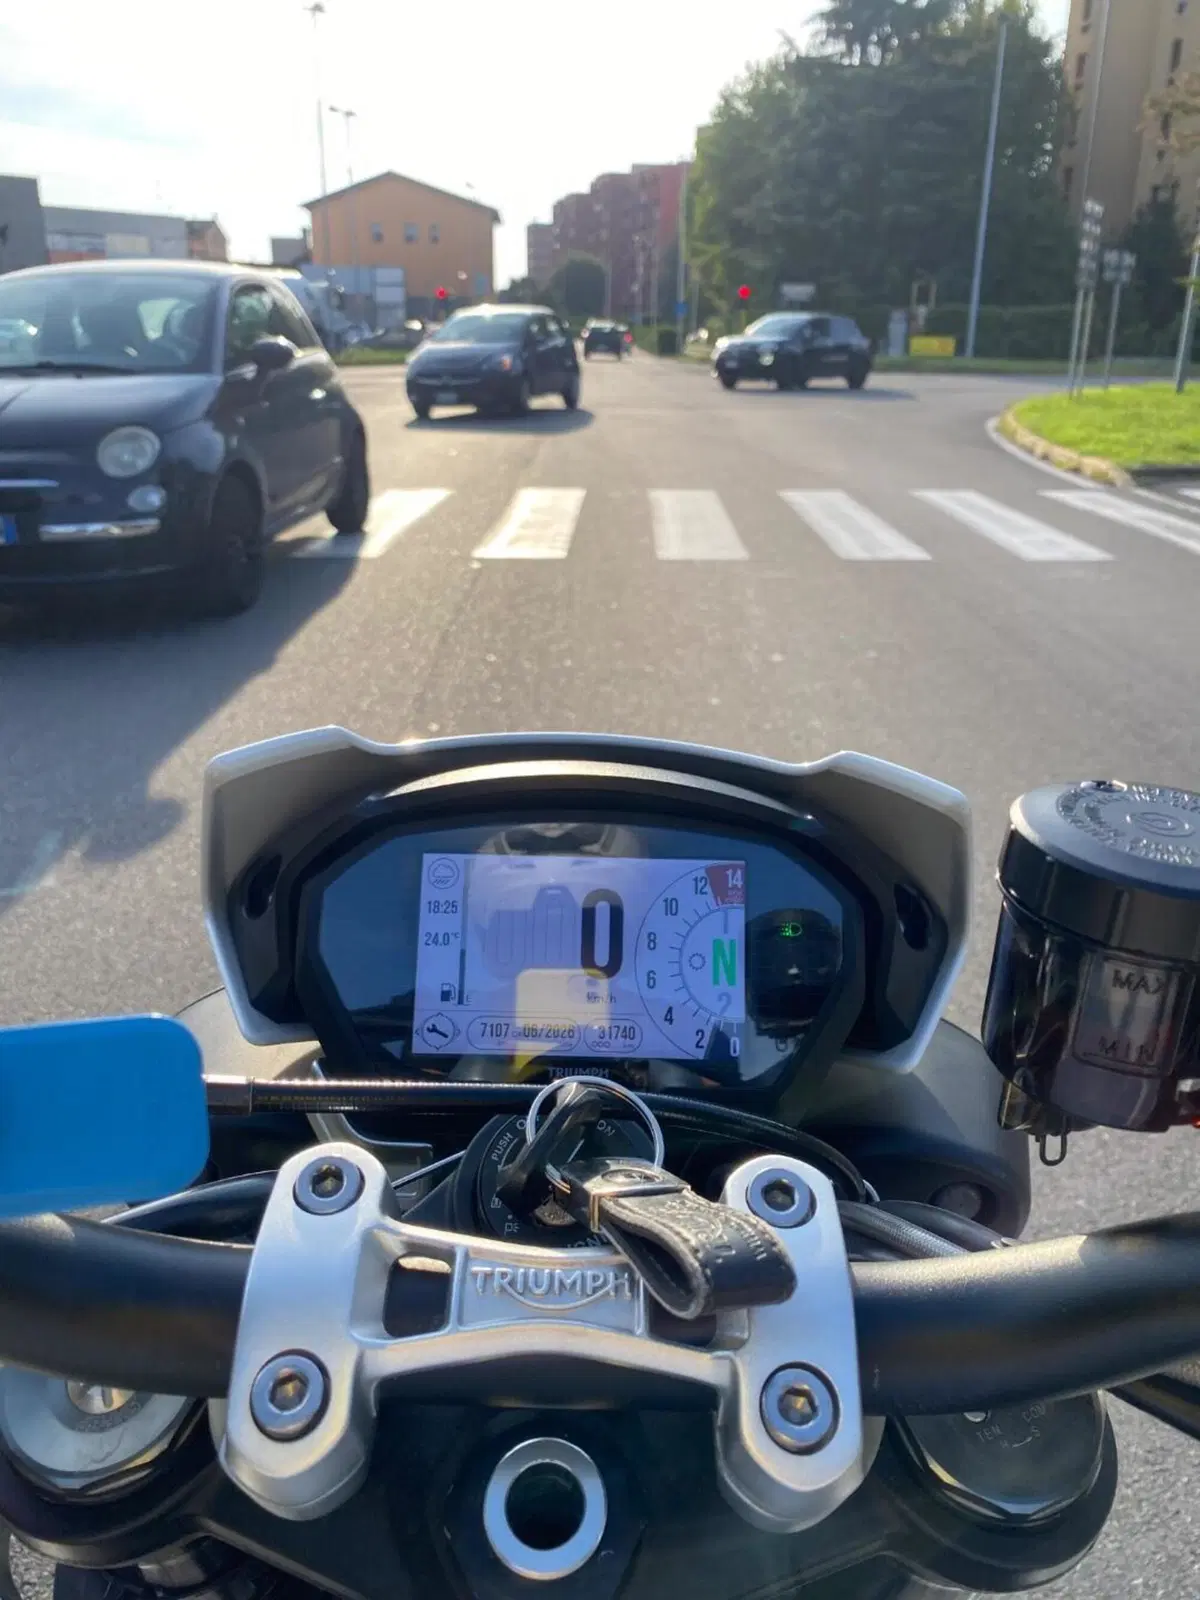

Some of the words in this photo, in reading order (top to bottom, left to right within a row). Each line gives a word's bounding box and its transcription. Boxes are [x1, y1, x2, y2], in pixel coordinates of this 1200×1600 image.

[692, 875, 708, 895] 12
[726, 868, 743, 888] 14
[427, 900, 458, 914] 18:25
[663, 897, 679, 916] 10
[581, 888, 624, 979] 0
[647, 931, 657, 950] 8
[712, 938, 737, 987] N
[647, 970, 657, 989] 6
[664, 1006, 675, 1026] 4
[480, 1022, 510, 1038] 7107
[694, 1029, 705, 1049] 2
[730, 1036, 740, 1057] 0
[547, 1066, 609, 1079] TRIUMPH
[596, 1119, 616, 1137] ON
[491, 1131, 514, 1161] PUSH
[471, 1266, 632, 1301] TRIUMPH
